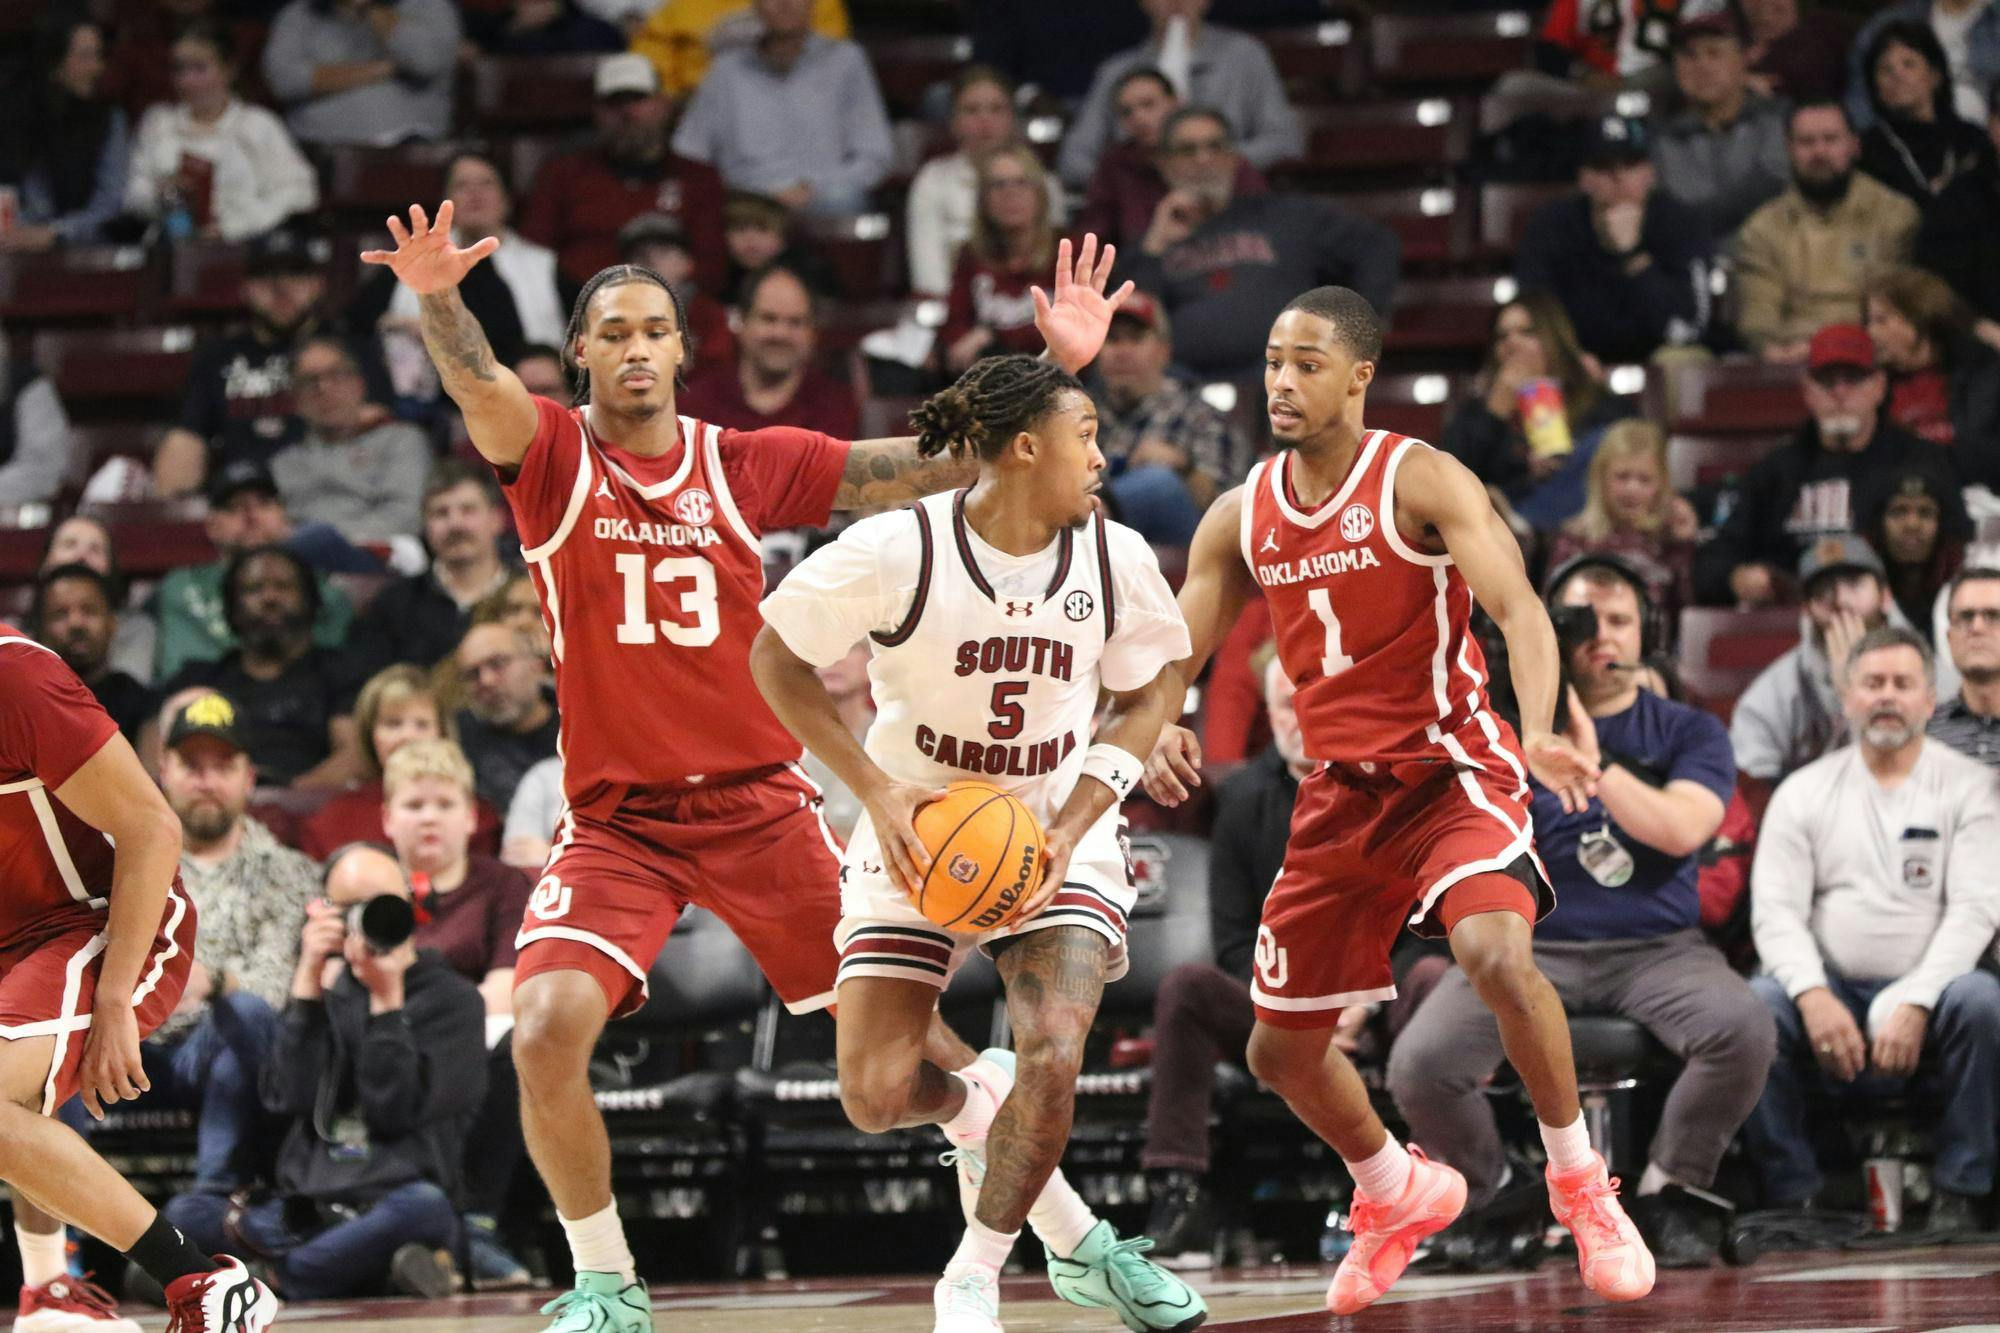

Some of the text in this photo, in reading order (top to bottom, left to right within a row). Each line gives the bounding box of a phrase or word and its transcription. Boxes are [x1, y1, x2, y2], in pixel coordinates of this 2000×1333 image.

[675, 489, 713, 527] SEC
[1341, 504, 1374, 542] SEC
[594, 517, 722, 548] OKLAHOMA
[1258, 546, 1381, 586] OKLAHOMA
[615, 553, 721, 647] 13
[1065, 591, 1094, 621] SEC
[1308, 588, 1354, 677] 1
[954, 636, 1074, 682] SOUTH
[987, 681, 1029, 740] 5
[968, 845, 1035, 928] Wilson
